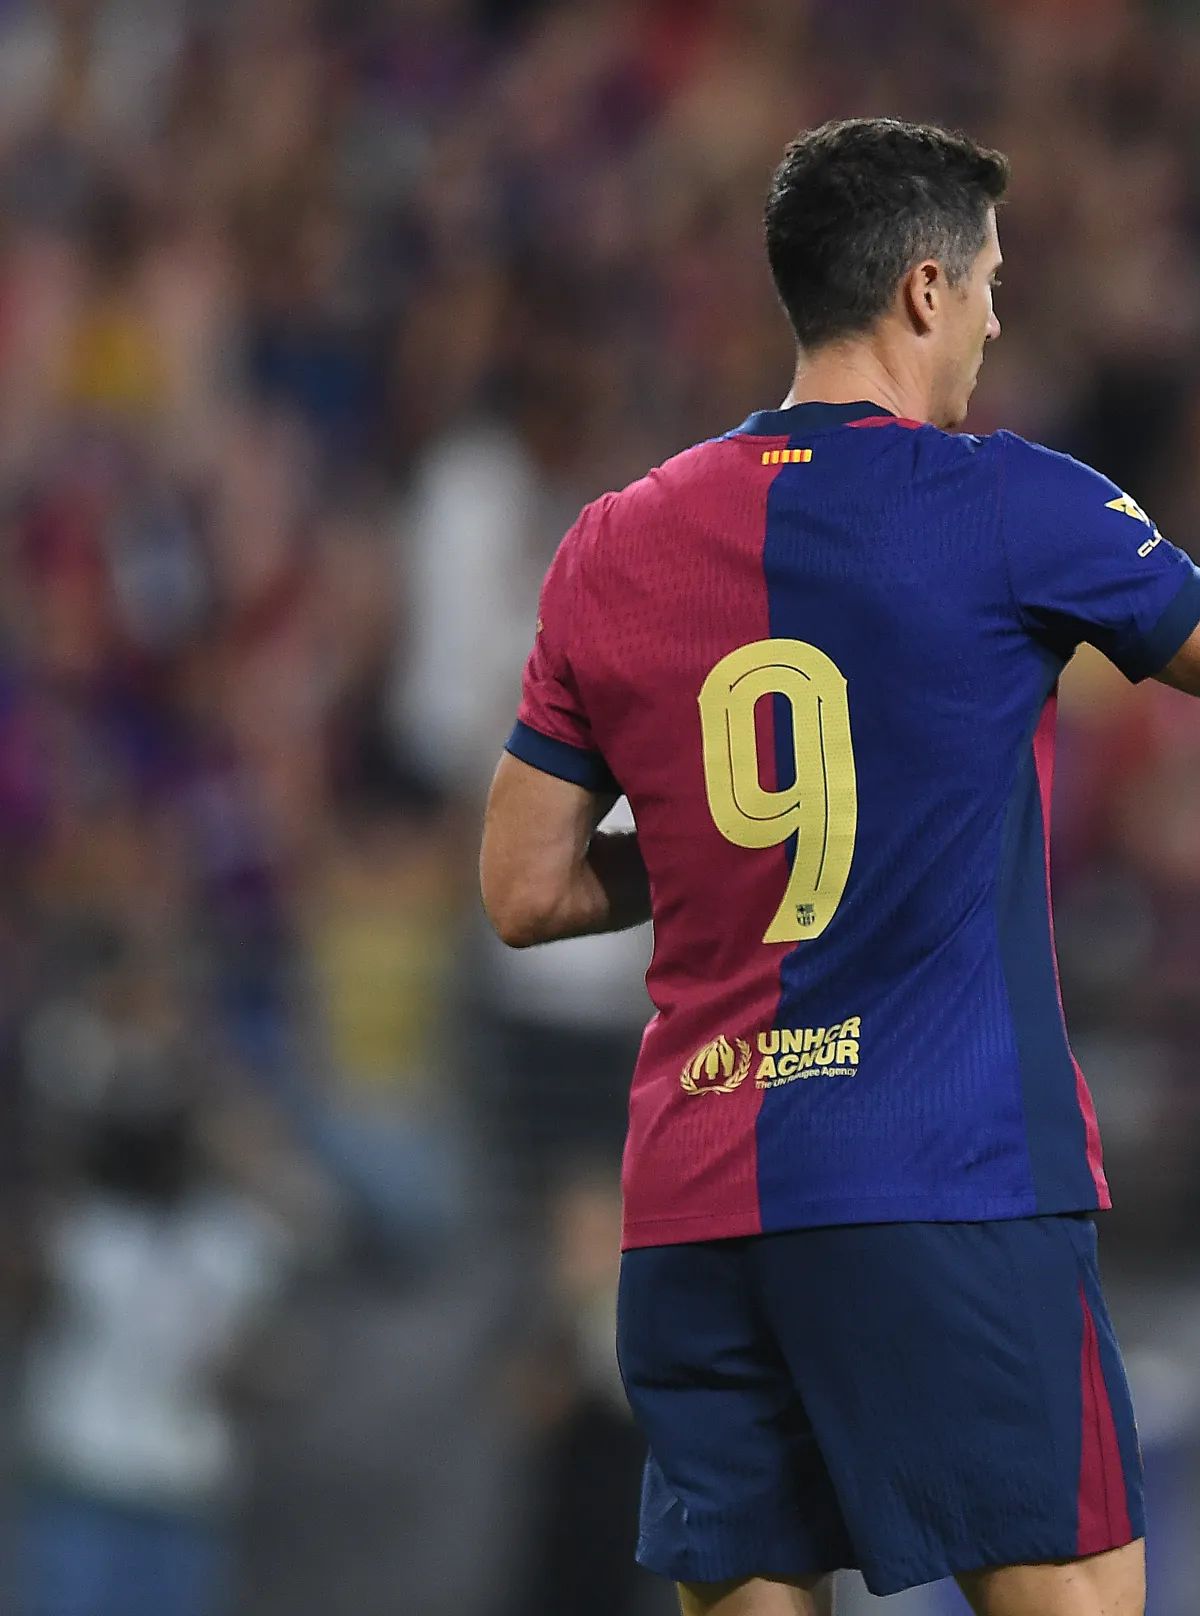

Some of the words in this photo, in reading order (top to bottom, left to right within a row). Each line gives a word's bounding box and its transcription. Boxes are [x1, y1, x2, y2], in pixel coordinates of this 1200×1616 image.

[698, 638, 857, 943] 9
[758, 1016, 861, 1055] UNHCR
[755, 1040, 859, 1079] ACNUR
[821, 1066, 857, 1077] Agency
